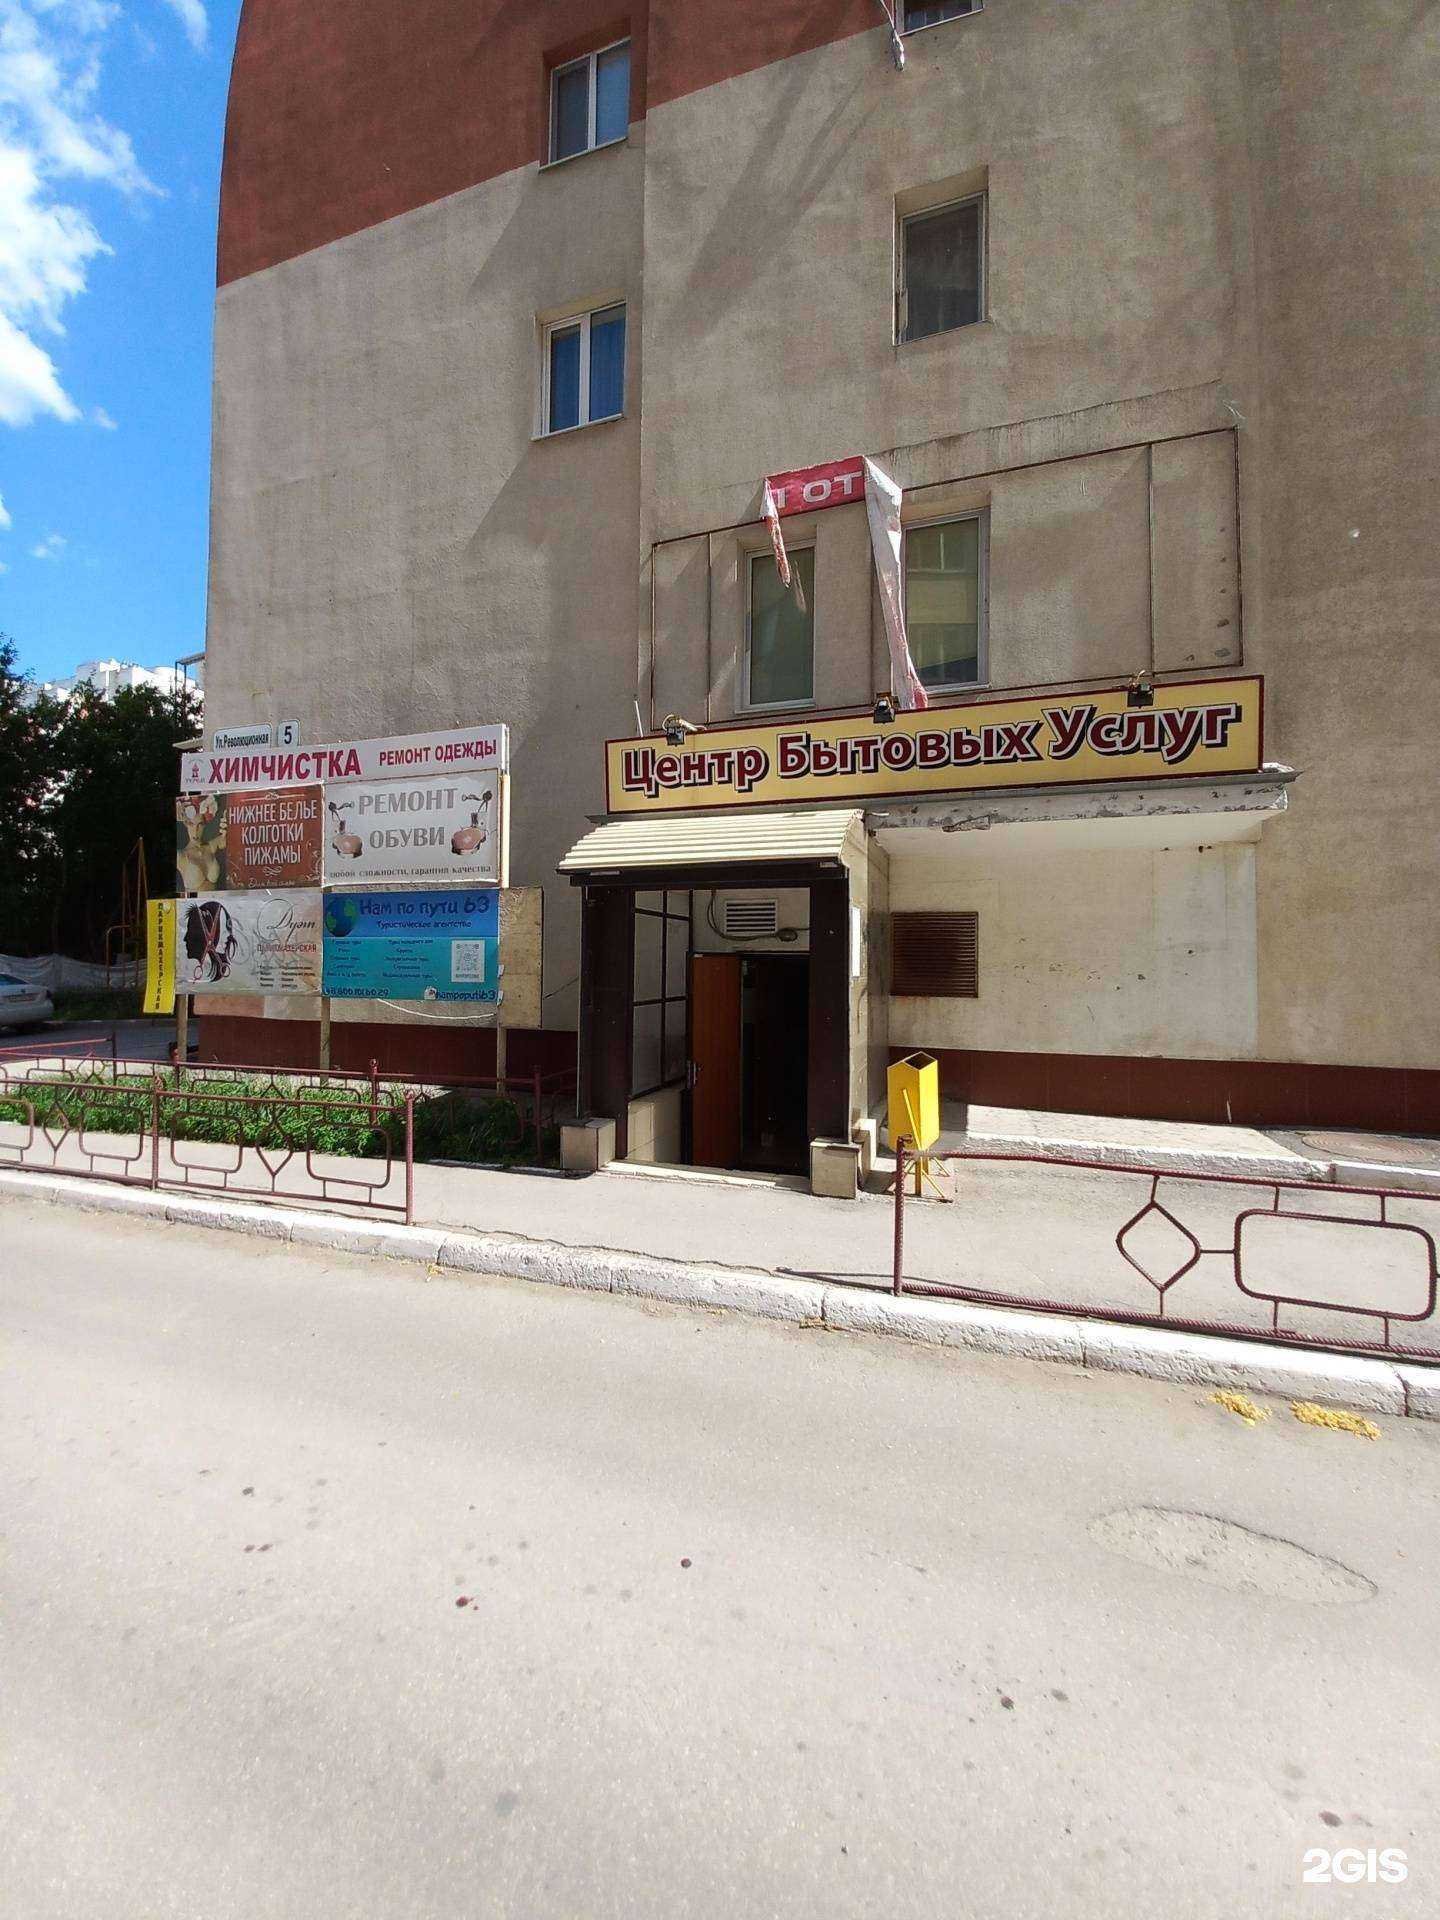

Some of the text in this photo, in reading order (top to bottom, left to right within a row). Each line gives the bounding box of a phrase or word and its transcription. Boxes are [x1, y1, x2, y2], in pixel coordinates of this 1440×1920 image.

[284, 725, 293, 745] 5
[209, 739, 497, 784] ХИМЧИСТКА РЕМОНТ ОДЕЖДЫ
[621, 703, 1242, 798] Центр Бытовых Услуг
[229, 799, 318, 825] НИЖНЕЕ БЕЛЬЕ
[358, 787, 458, 815] РЕМОНТ
[241, 822, 304, 844] КОЛГОТКИ
[369, 826, 445, 849] ОБУВИ
[244, 844, 301, 866] ПИЖАМЫ
[411, 867, 449, 876] гарантия
[452, 866, 491, 874] качества
[360, 895, 490, 918] Нам по пути 63
